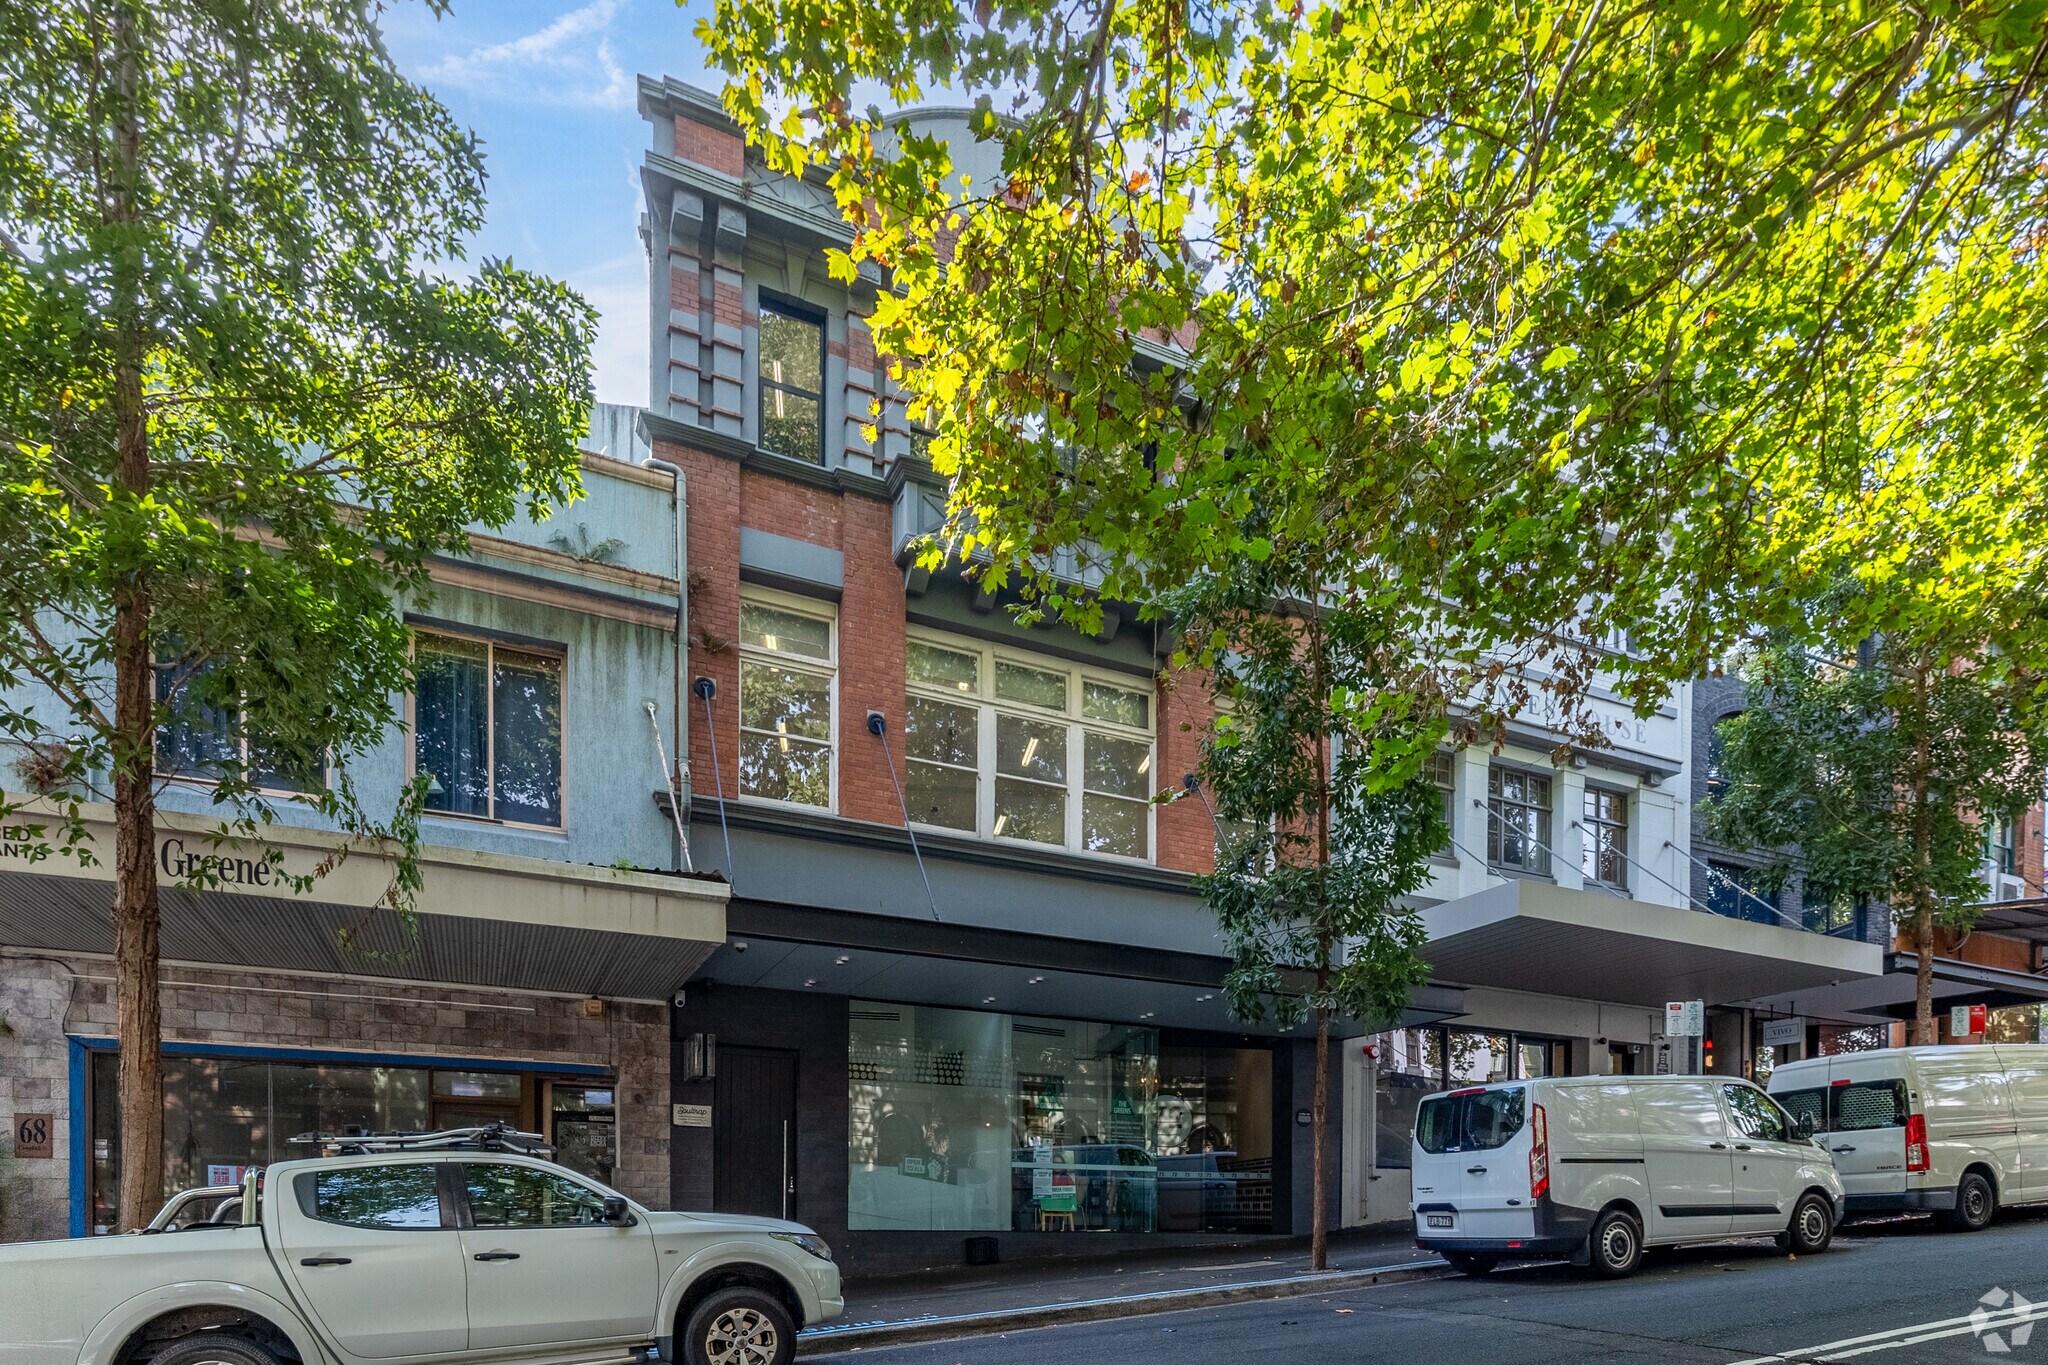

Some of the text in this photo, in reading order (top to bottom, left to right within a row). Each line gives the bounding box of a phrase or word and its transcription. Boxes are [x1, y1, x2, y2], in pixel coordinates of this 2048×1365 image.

[0, 825, 31, 842] ED
[161, 838, 270, 886] Grene
[1772, 1027, 1792, 1036] VIVO
[1118, 1100, 1127, 1108] THE
[1113, 1107, 1132, 1115] GREENS
[20, 1118, 46, 1144] 68
